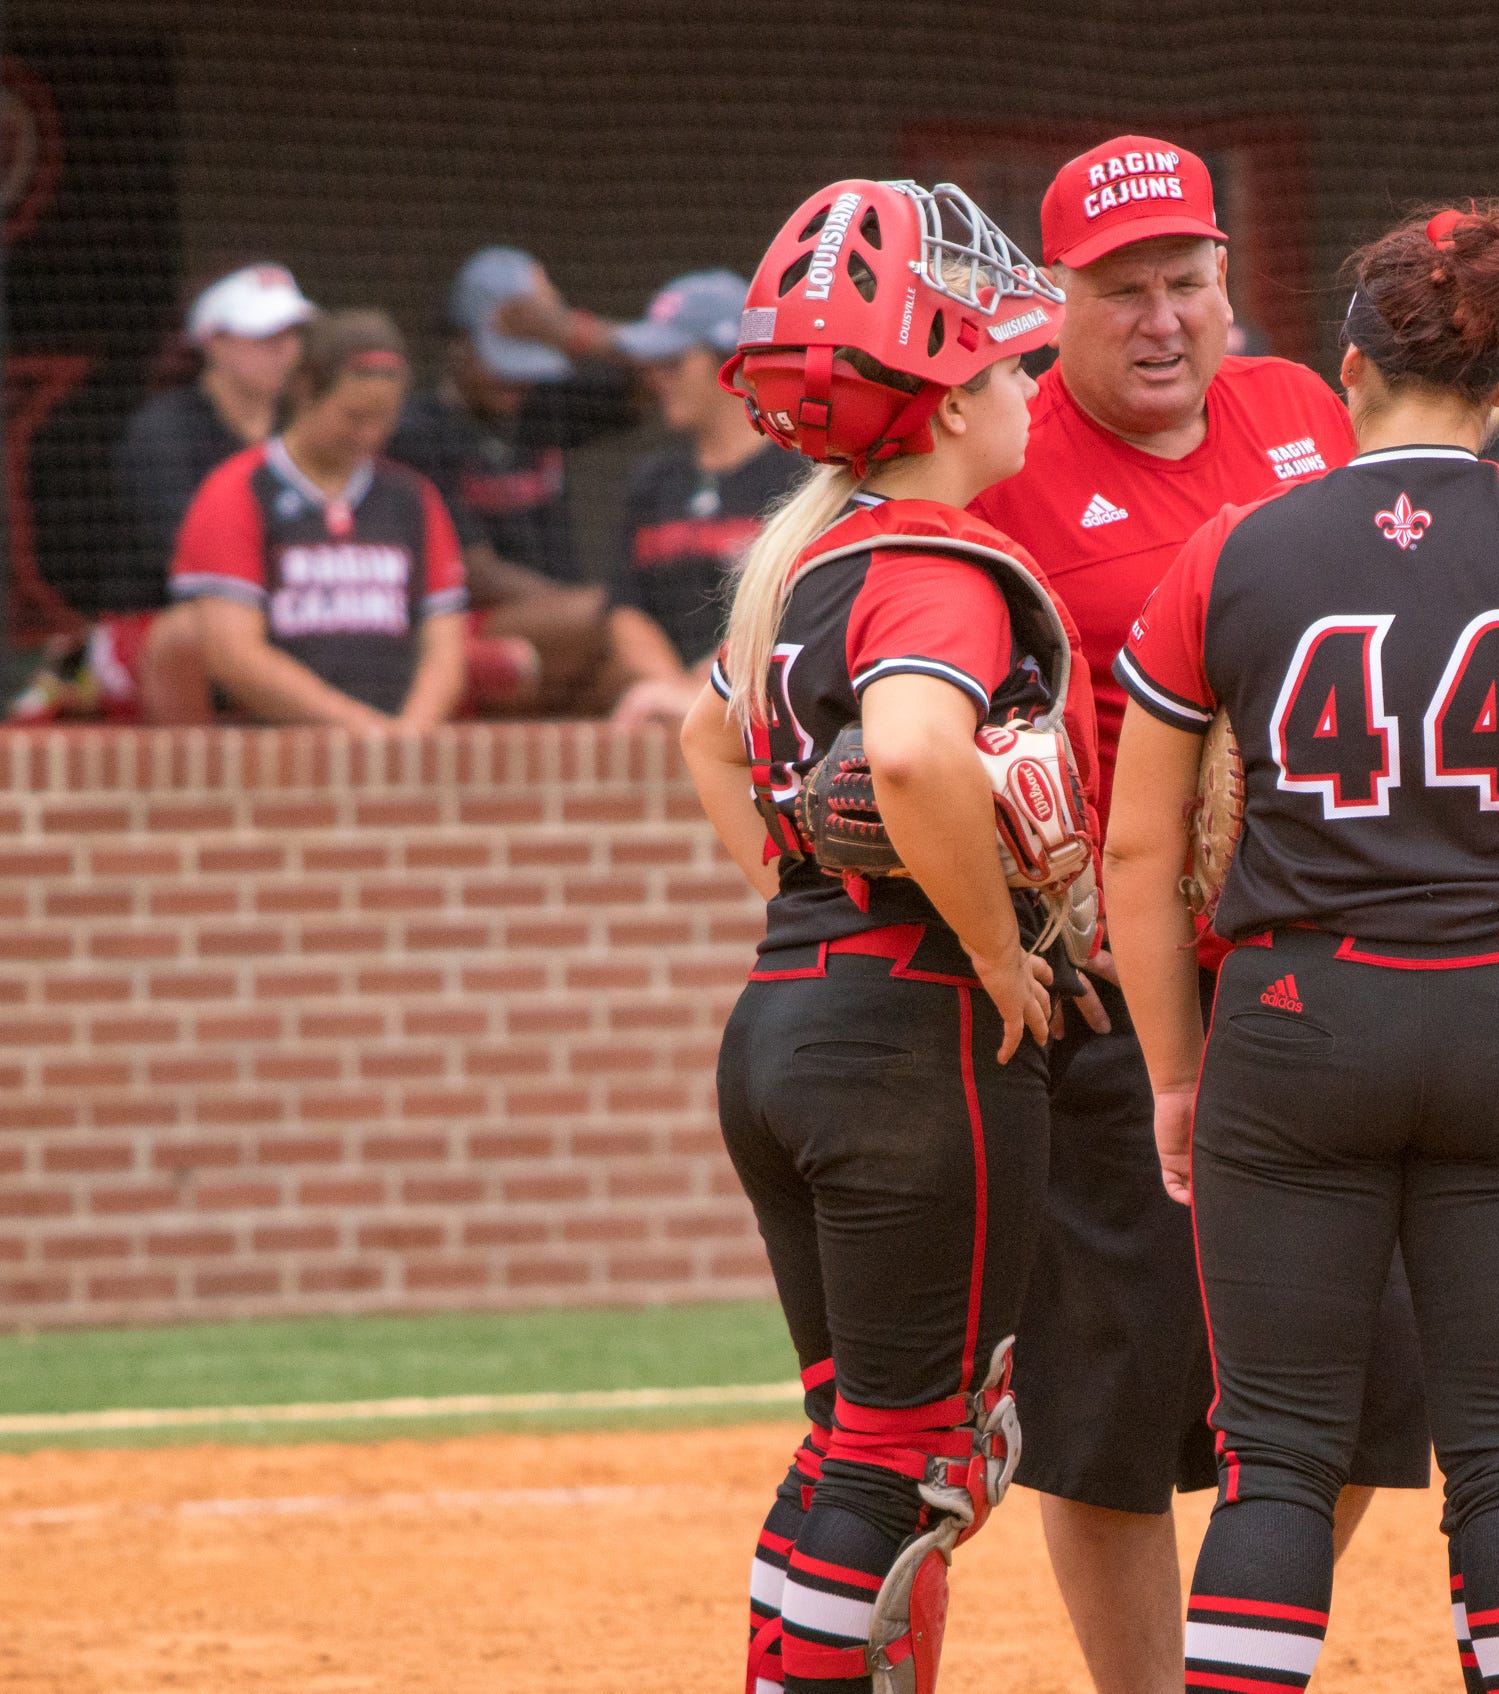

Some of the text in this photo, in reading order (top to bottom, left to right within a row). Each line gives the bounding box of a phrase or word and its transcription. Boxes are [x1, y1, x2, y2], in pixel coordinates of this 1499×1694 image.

[1084, 177, 1183, 219] CAJUNS
[804, 192, 862, 301] LOUISIANA
[899, 286, 916, 345] LOUISVILLE
[1273, 454, 1328, 481] CAJUNS
[1081, 507, 1129, 529] adidas
[1021, 767, 1051, 819] Wilson
[1260, 992, 1303, 1013] adidas
